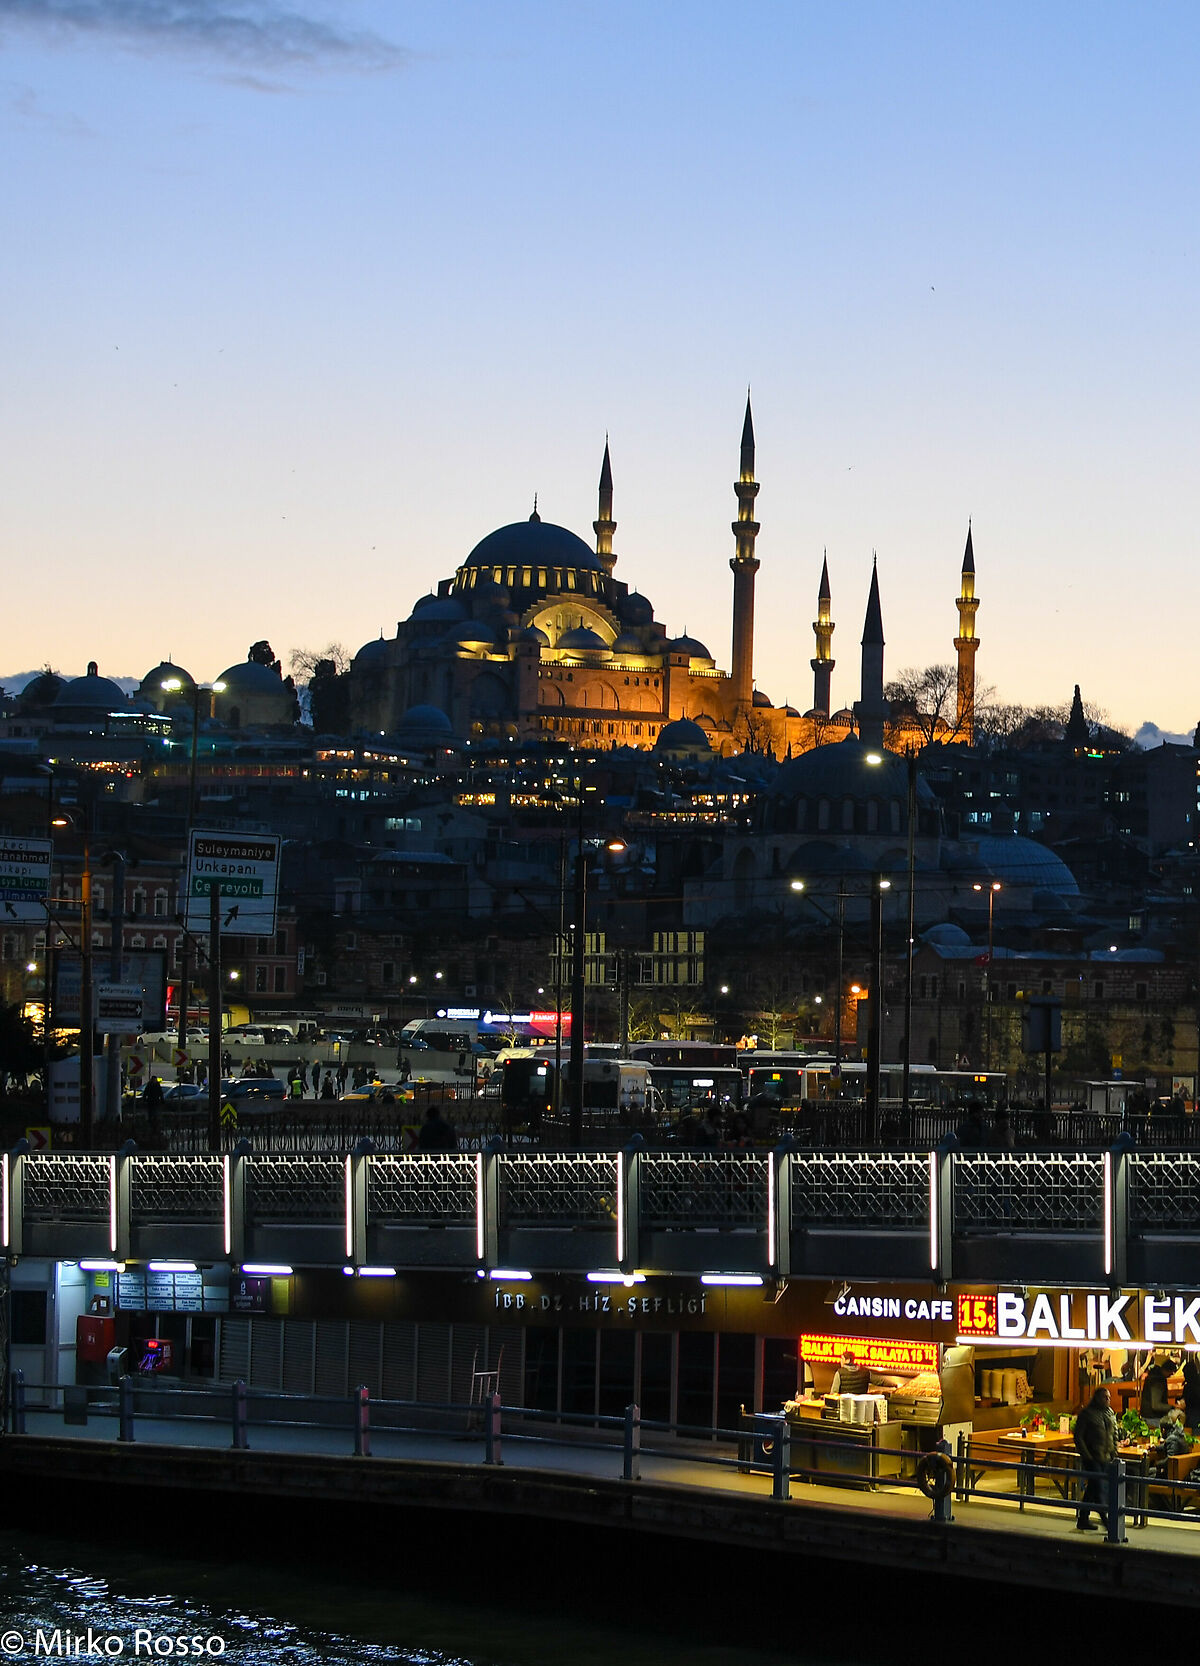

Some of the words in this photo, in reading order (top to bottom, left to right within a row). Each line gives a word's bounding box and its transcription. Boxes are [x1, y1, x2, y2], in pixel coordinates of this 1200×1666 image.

[195, 859, 256, 876] Unkapanı
[195, 879, 260, 895] Çereyolu
[834, 1296, 901, 1318] CANSIN
[904, 1299, 954, 1321] CAFE
[997, 1292, 1131, 1341] BALIK
[803, 1341, 833, 1357] BALIK
[869, 1347, 911, 1363] SALATA
[911, 1350, 923, 1363] 15
[924, 1349, 934, 1361] TL
